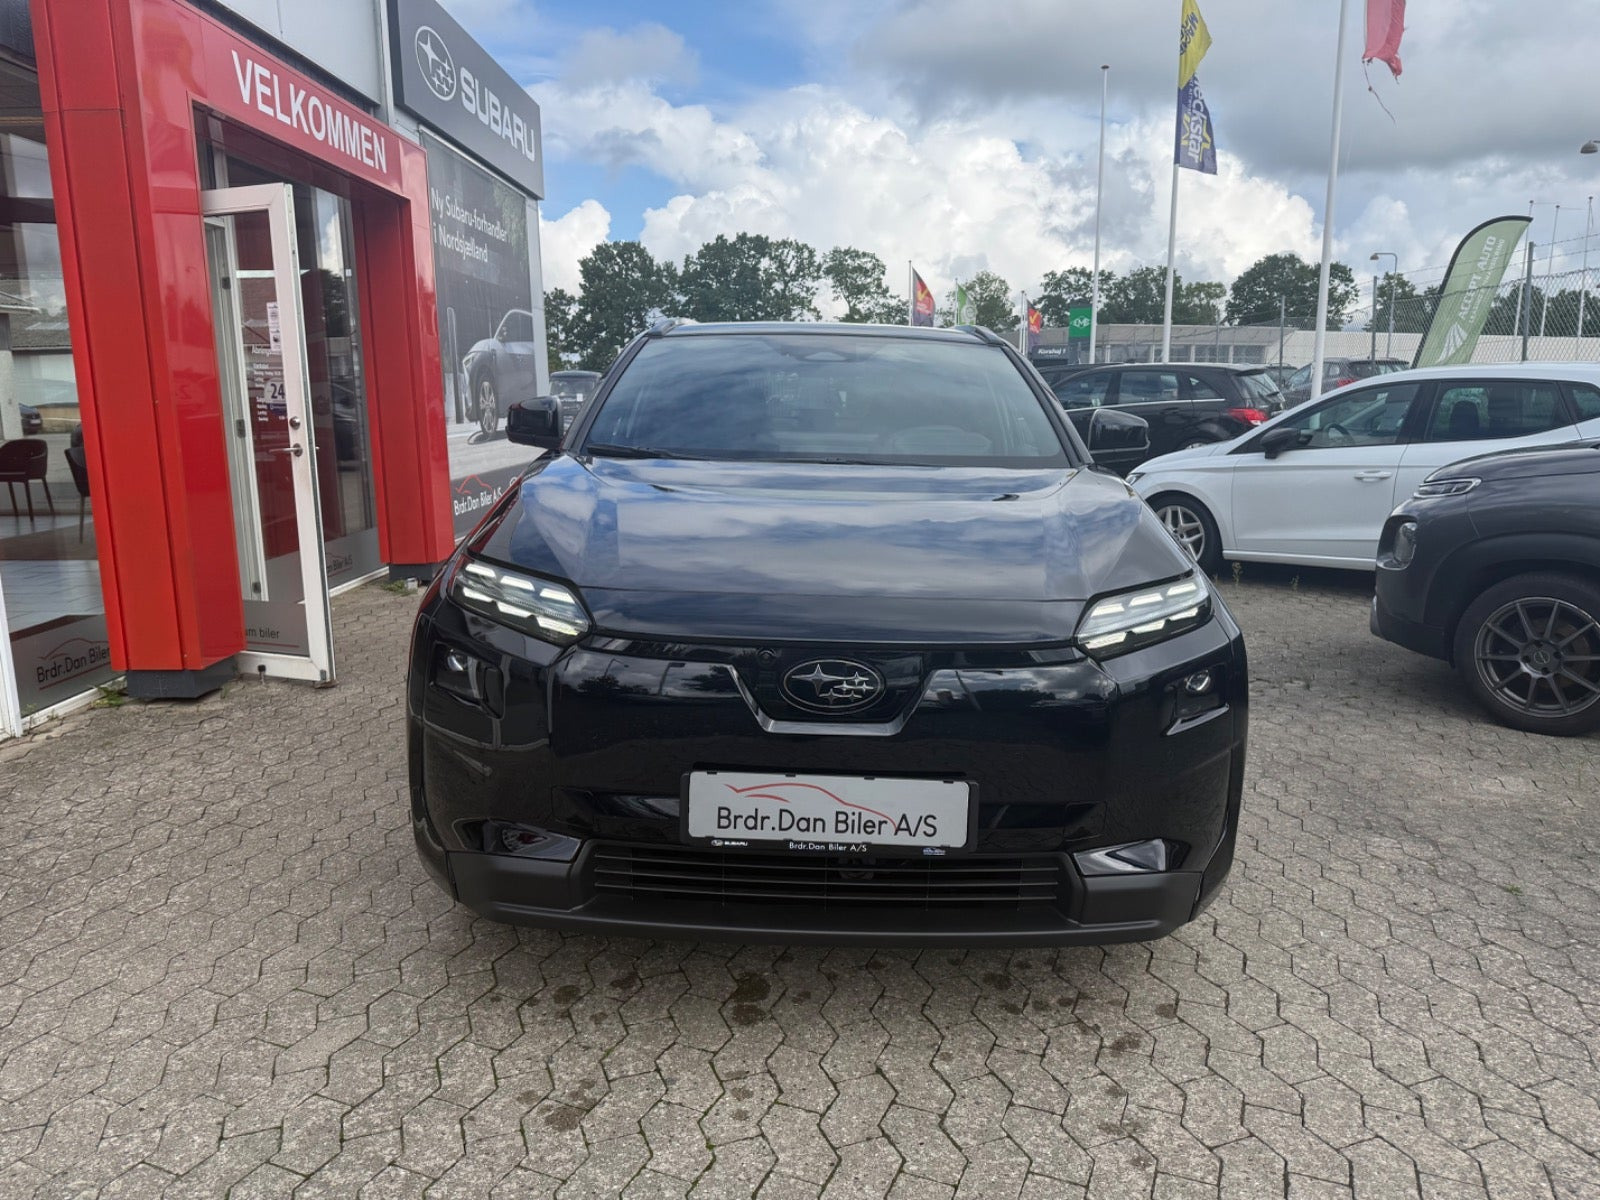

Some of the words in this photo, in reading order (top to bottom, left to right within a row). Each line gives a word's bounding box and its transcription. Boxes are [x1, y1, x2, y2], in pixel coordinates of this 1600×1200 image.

[231, 49, 387, 174] VELKOMMEN
[460, 66, 536, 162] SUBARU
[431, 187, 443, 219] Ny
[445, 194, 509, 243] Subaru-forhandler
[433, 222, 437, 243] i
[438, 223, 488, 262] Nordsjælland
[1458, 273, 1482, 320] ACCEPT
[1477, 235, 1497, 271] AUTO
[270, 383, 285, 399] 24
[453, 496, 480, 515] Brdr.Dan
[480, 491, 492, 507] Biler
[258, 627, 280, 639] biler
[36, 656, 87, 683] Brdr.Dan
[717, 806, 826, 833] Brdr.Dan
[834, 811, 888, 836] Biler
[894, 813, 938, 837] A/S
[788, 841, 826, 850] Brdr.Dan
[828, 843, 847, 851] Biler
[849, 844, 867, 852] A/S
